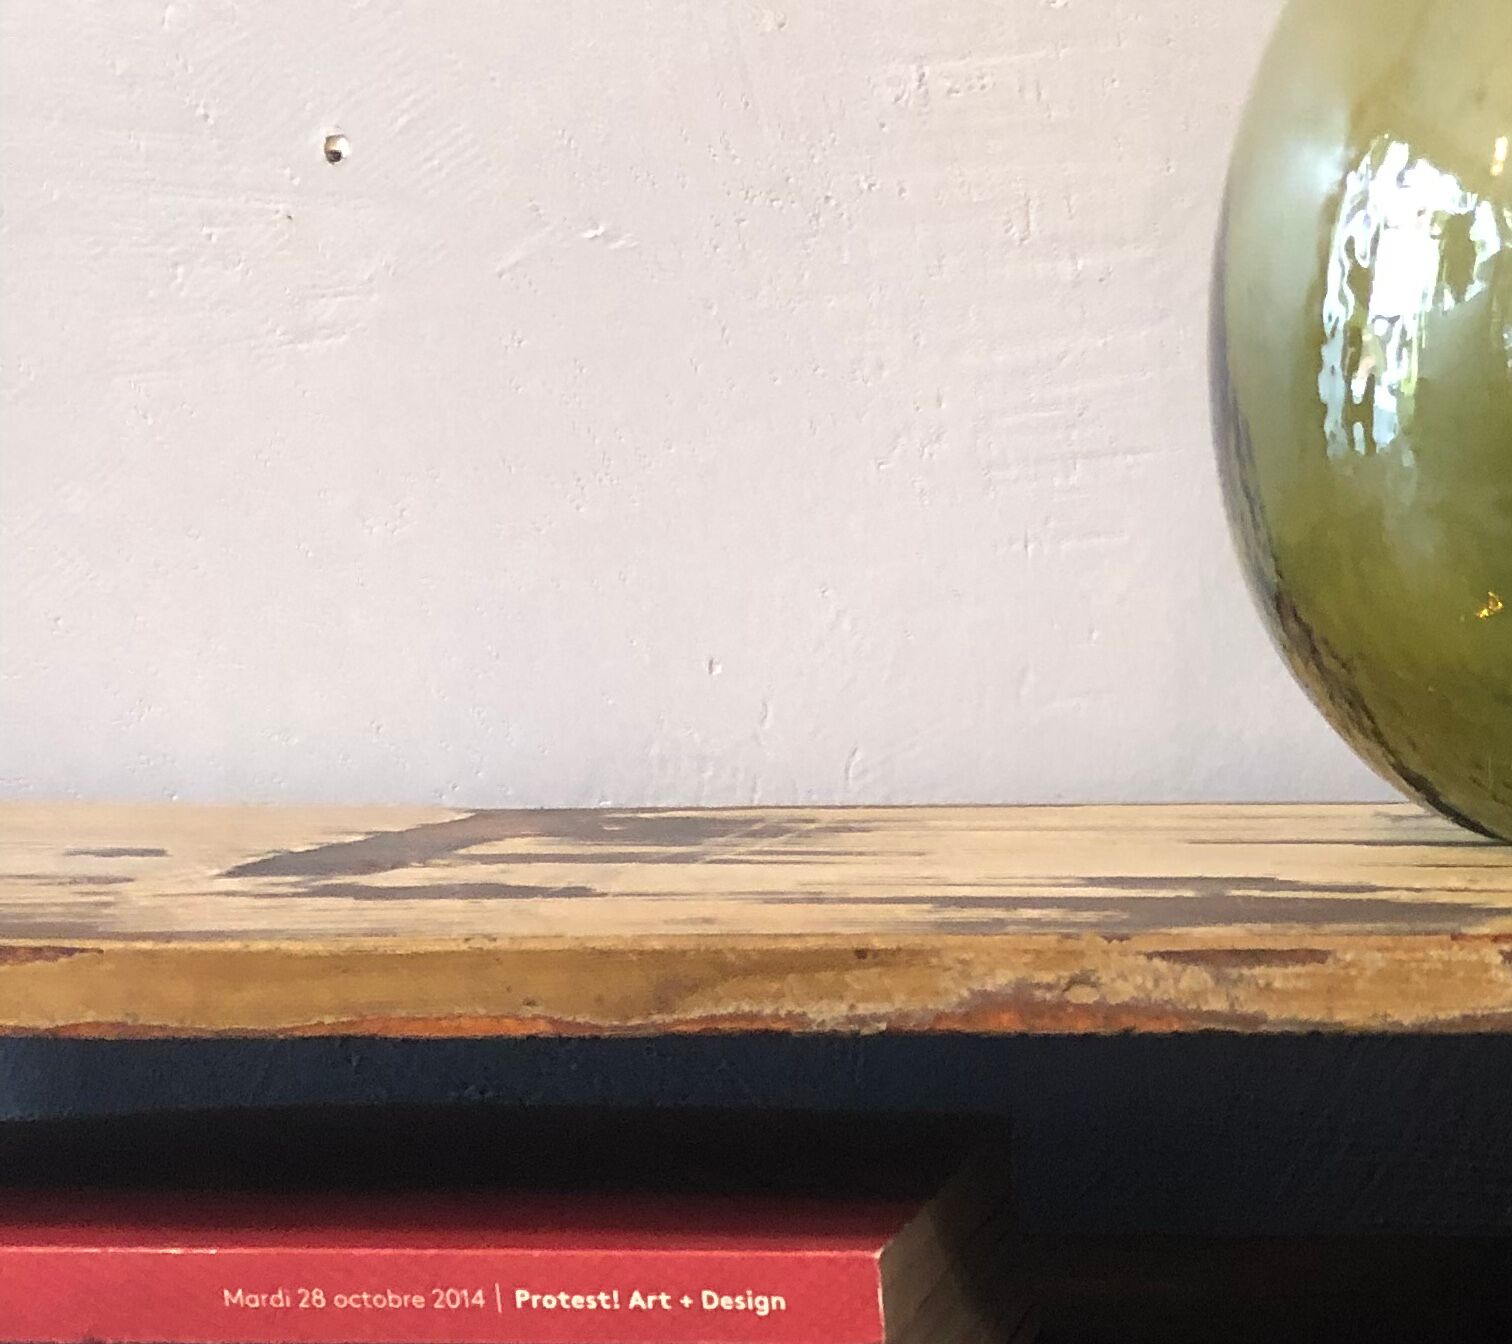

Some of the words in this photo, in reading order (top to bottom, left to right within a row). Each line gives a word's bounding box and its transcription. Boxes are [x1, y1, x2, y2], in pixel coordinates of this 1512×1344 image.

[222, 1288, 291, 1310] Mardi
[297, 1288, 327, 1310] 28
[332, 1288, 426, 1310] octobre
[431, 1288, 487, 1310] 2014
[513, 1288, 620, 1311] Protest!
[628, 1288, 672, 1311] Art
[679, 1294, 694, 1309] +
[700, 1288, 787, 1317] Design
